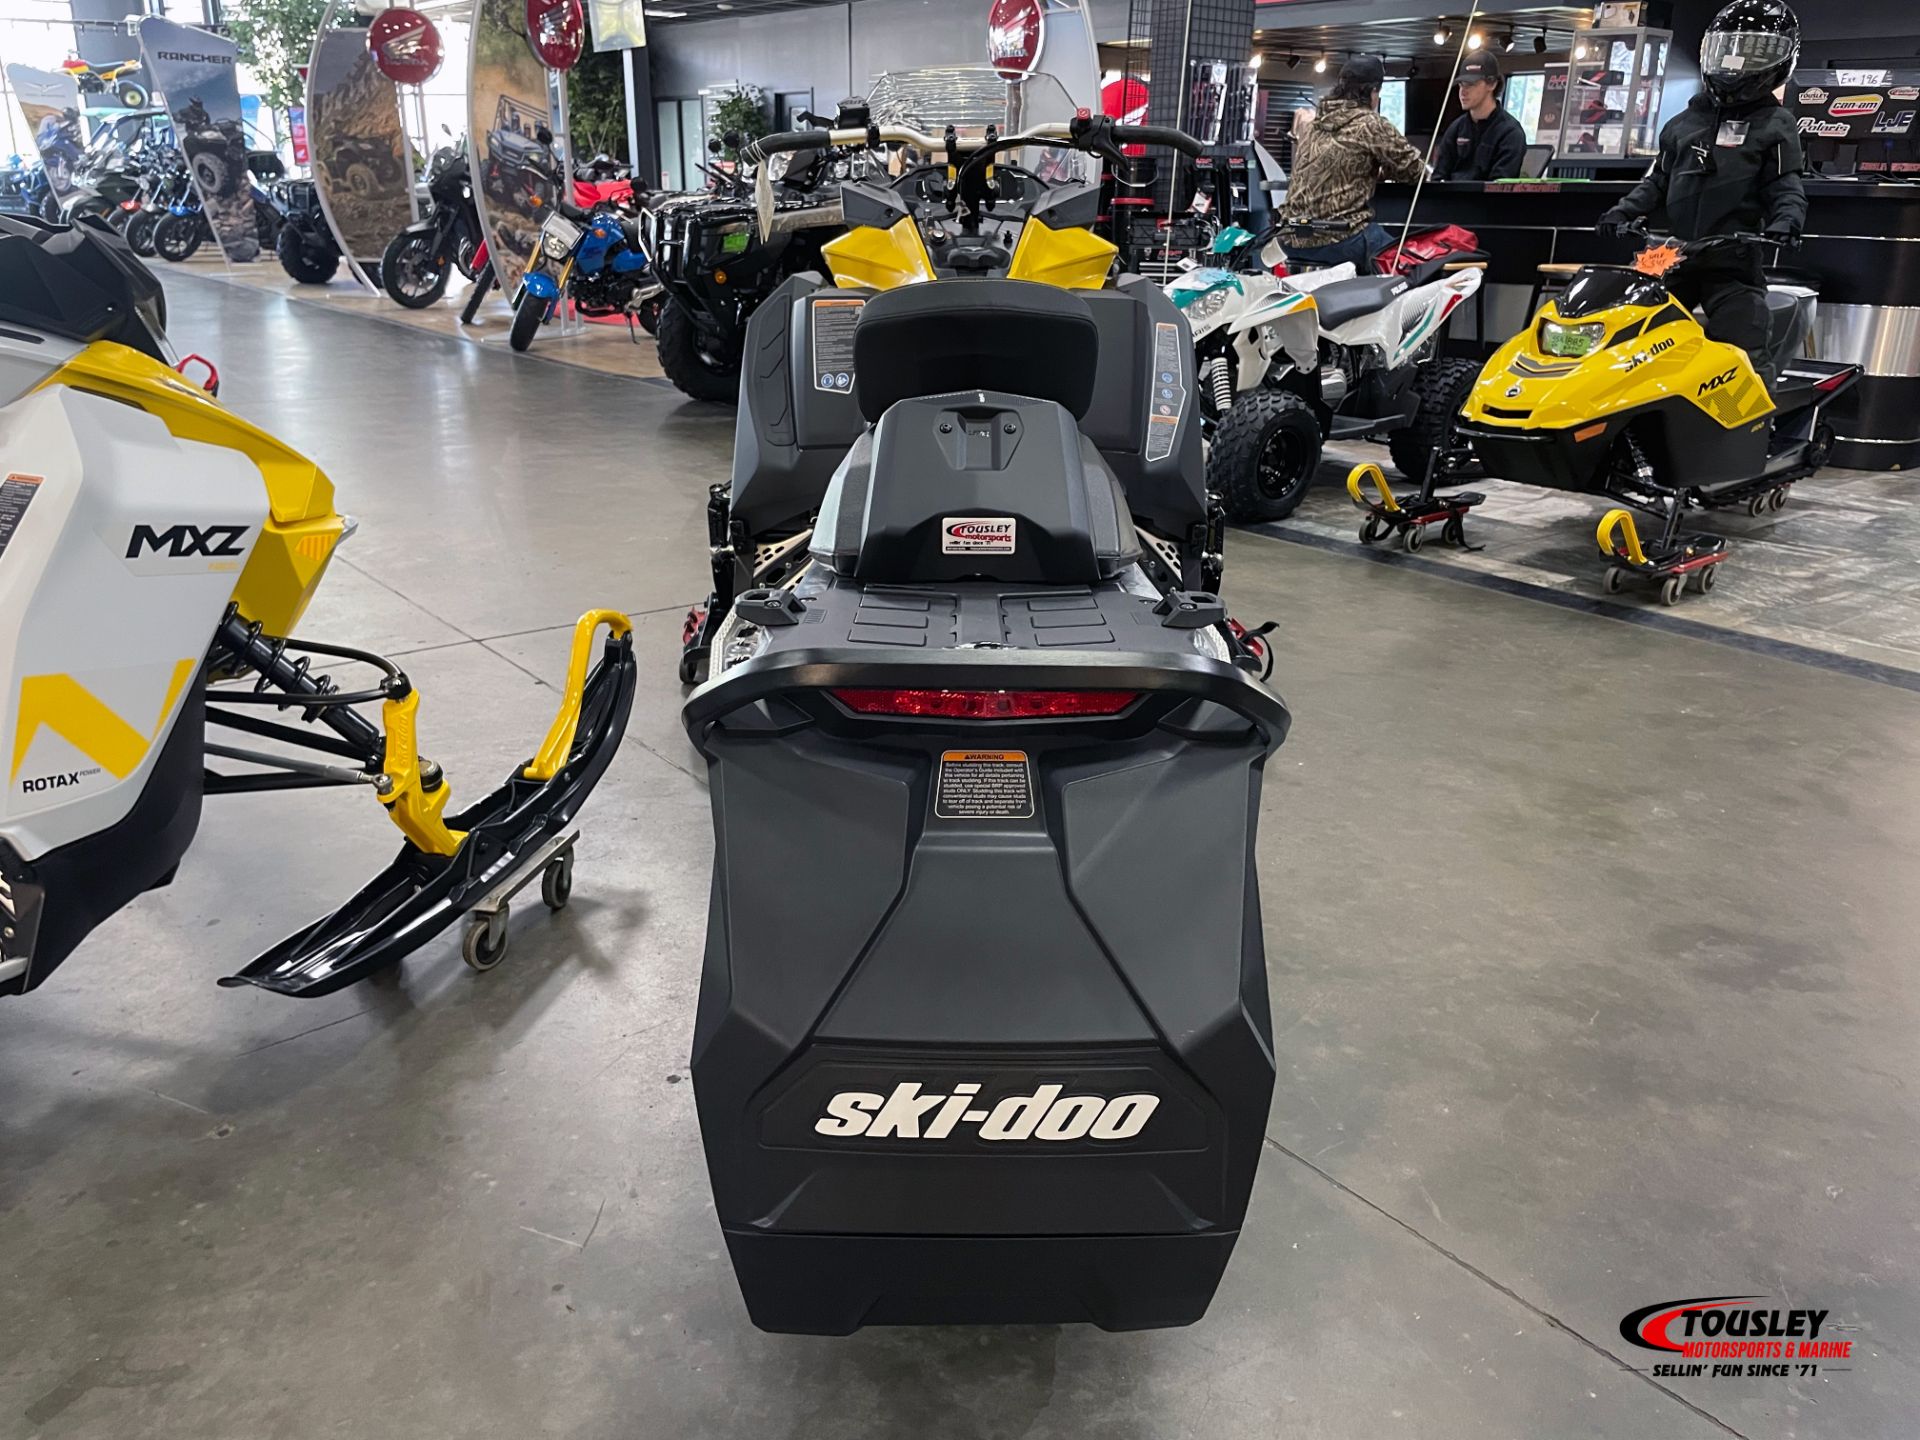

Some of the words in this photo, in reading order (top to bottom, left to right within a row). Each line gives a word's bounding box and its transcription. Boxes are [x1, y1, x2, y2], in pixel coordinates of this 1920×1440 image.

[157, 51, 232, 64] RANCHER
[1797, 118, 1848, 133] Polaris
[1697, 366, 1739, 397] MXZ
[960, 525, 1011, 534] TOUSLEY
[965, 534, 1011, 542] motorsports
[125, 525, 250, 558] MXZ
[23, 772, 79, 793] ROTAX
[815, 1083, 1160, 1140] ski-doo
